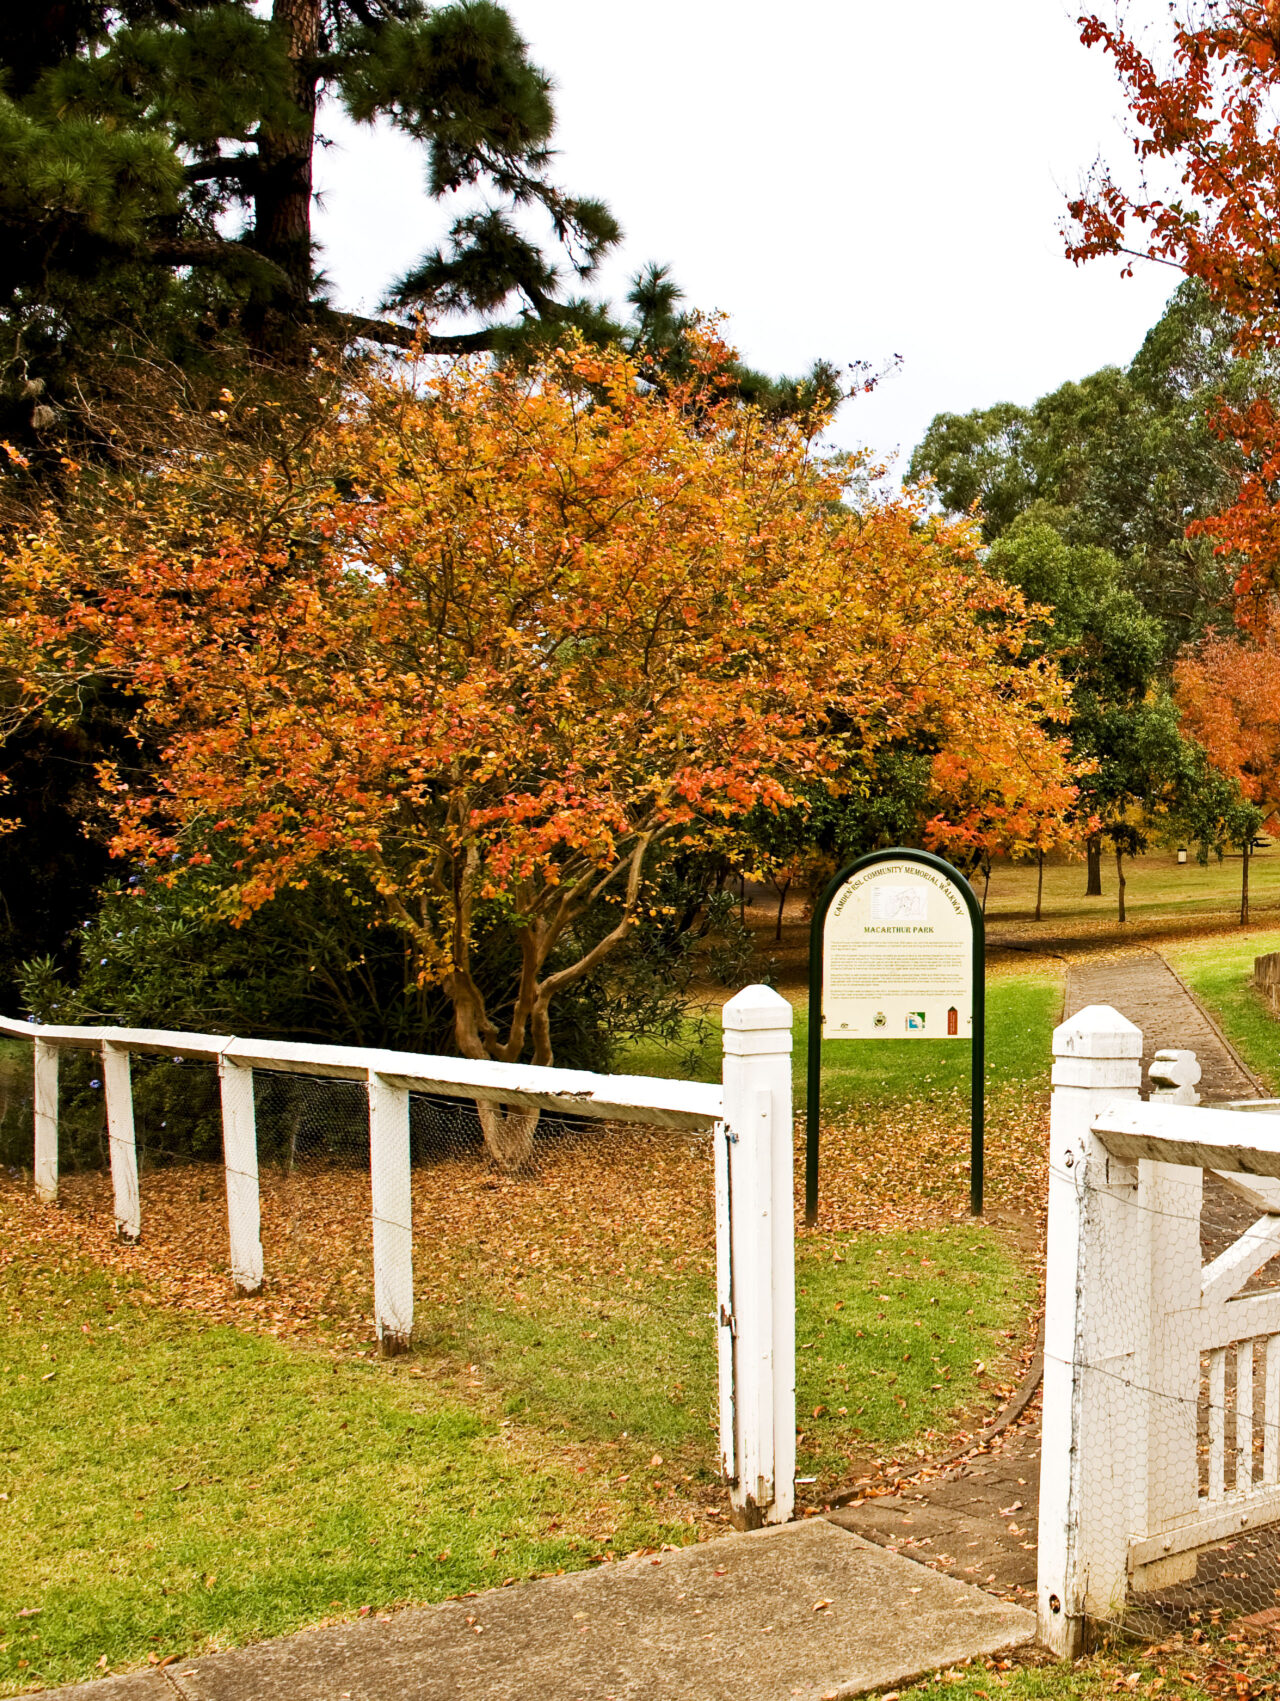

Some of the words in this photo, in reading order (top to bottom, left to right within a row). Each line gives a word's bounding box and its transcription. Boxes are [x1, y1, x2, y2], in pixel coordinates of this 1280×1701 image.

[834, 890, 853, 917] CAMDEN
[852, 879, 865, 891] RSL
[863, 866, 903, 882] COMMUNITY
[905, 866, 938, 886] MEMORIAL
[939, 882, 965, 916] WALKWAY
[864, 926, 911, 934] MACARTHUR
[913, 926, 934, 934] PARK
